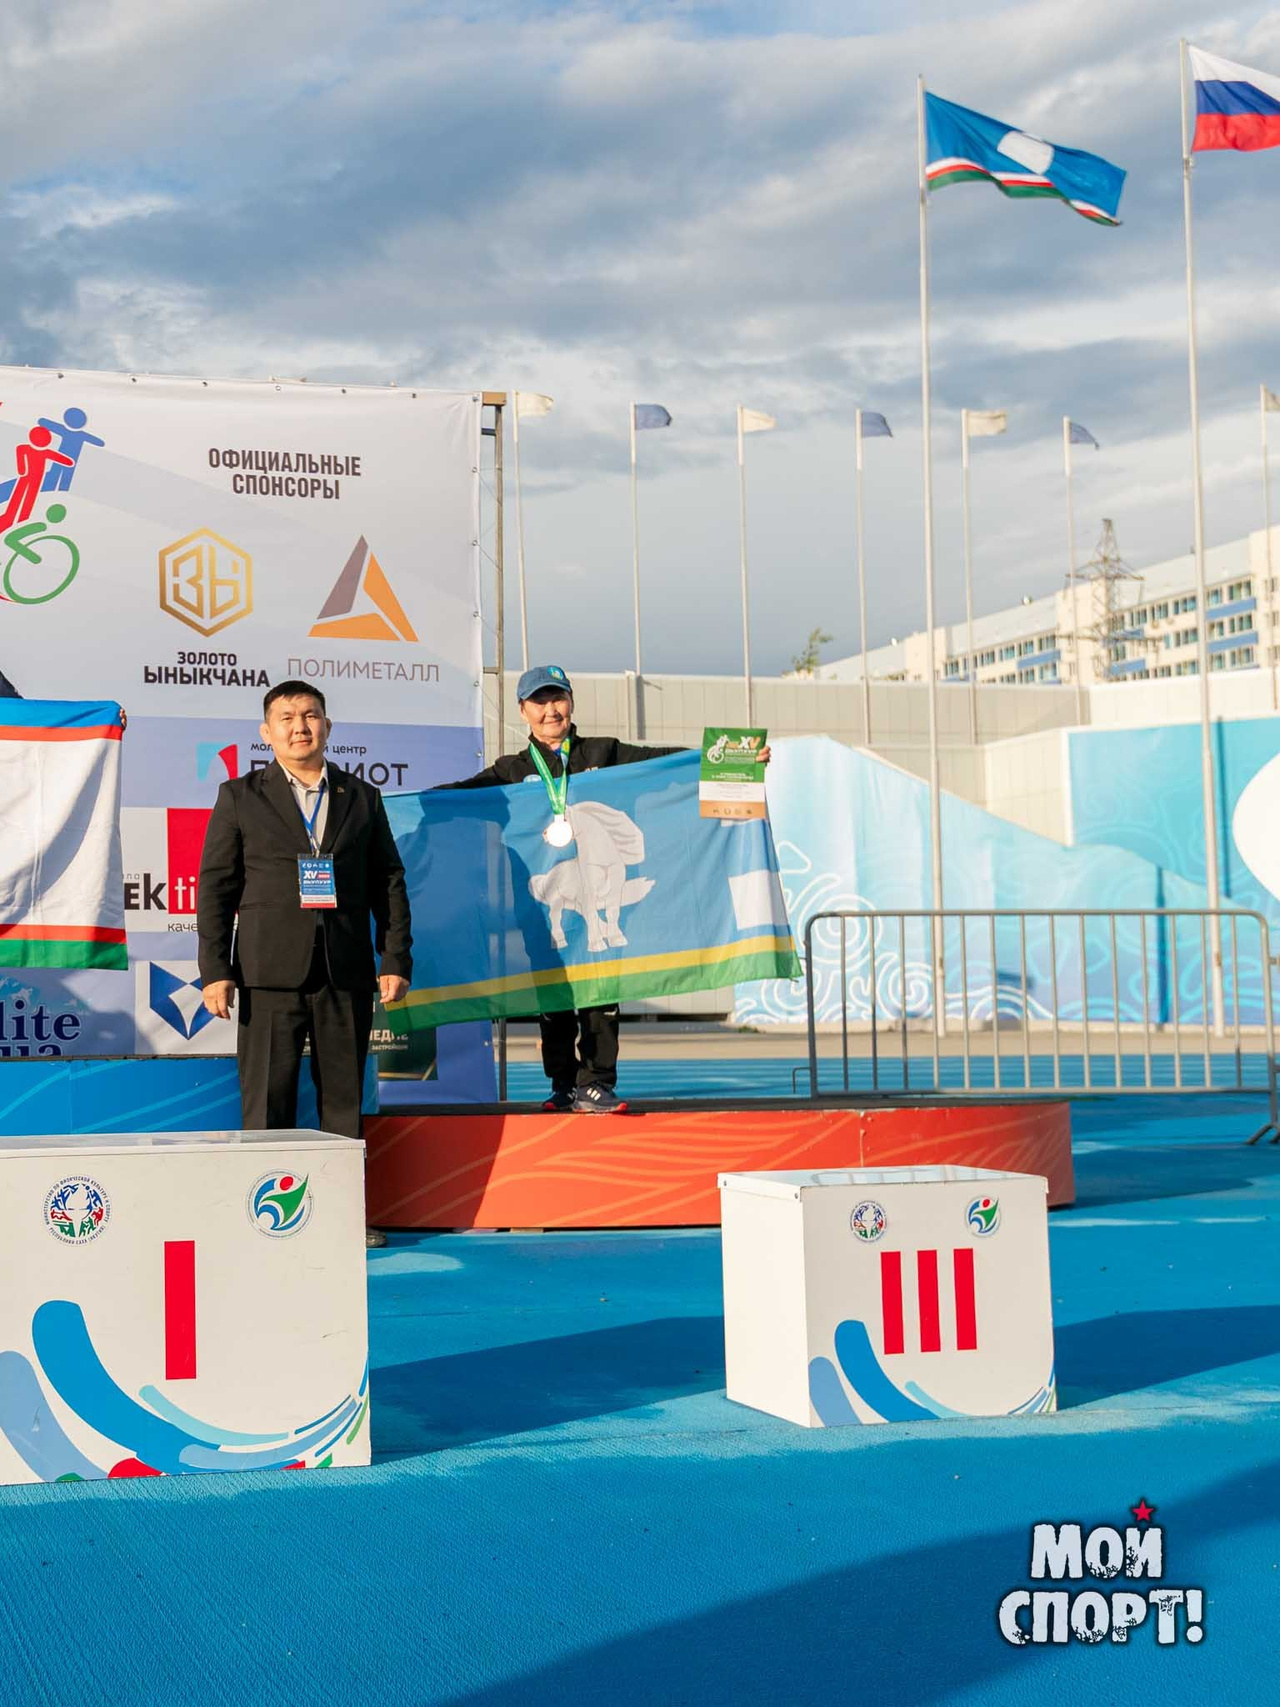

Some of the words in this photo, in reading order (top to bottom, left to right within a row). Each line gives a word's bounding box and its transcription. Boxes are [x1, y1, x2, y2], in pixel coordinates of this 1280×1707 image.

[208, 447, 361, 477] ОФИЦИАЛЬНЫЕ
[232, 473, 340, 500] СПОНСОРЫ
[177, 651, 237, 667] ЗОЛОТО
[287, 658, 440, 682] ПОЛИМЕТАЛЛ
[143, 666, 270, 688] ЫНЫКЧАНА
[333, 744, 367, 757] центр
[740, 736, 761, 749] XV
[303, 870, 318, 879] XV
[168, 923, 199, 932] каче
[164, 1240, 197, 1380] I
[880, 1248, 977, 1355] III
